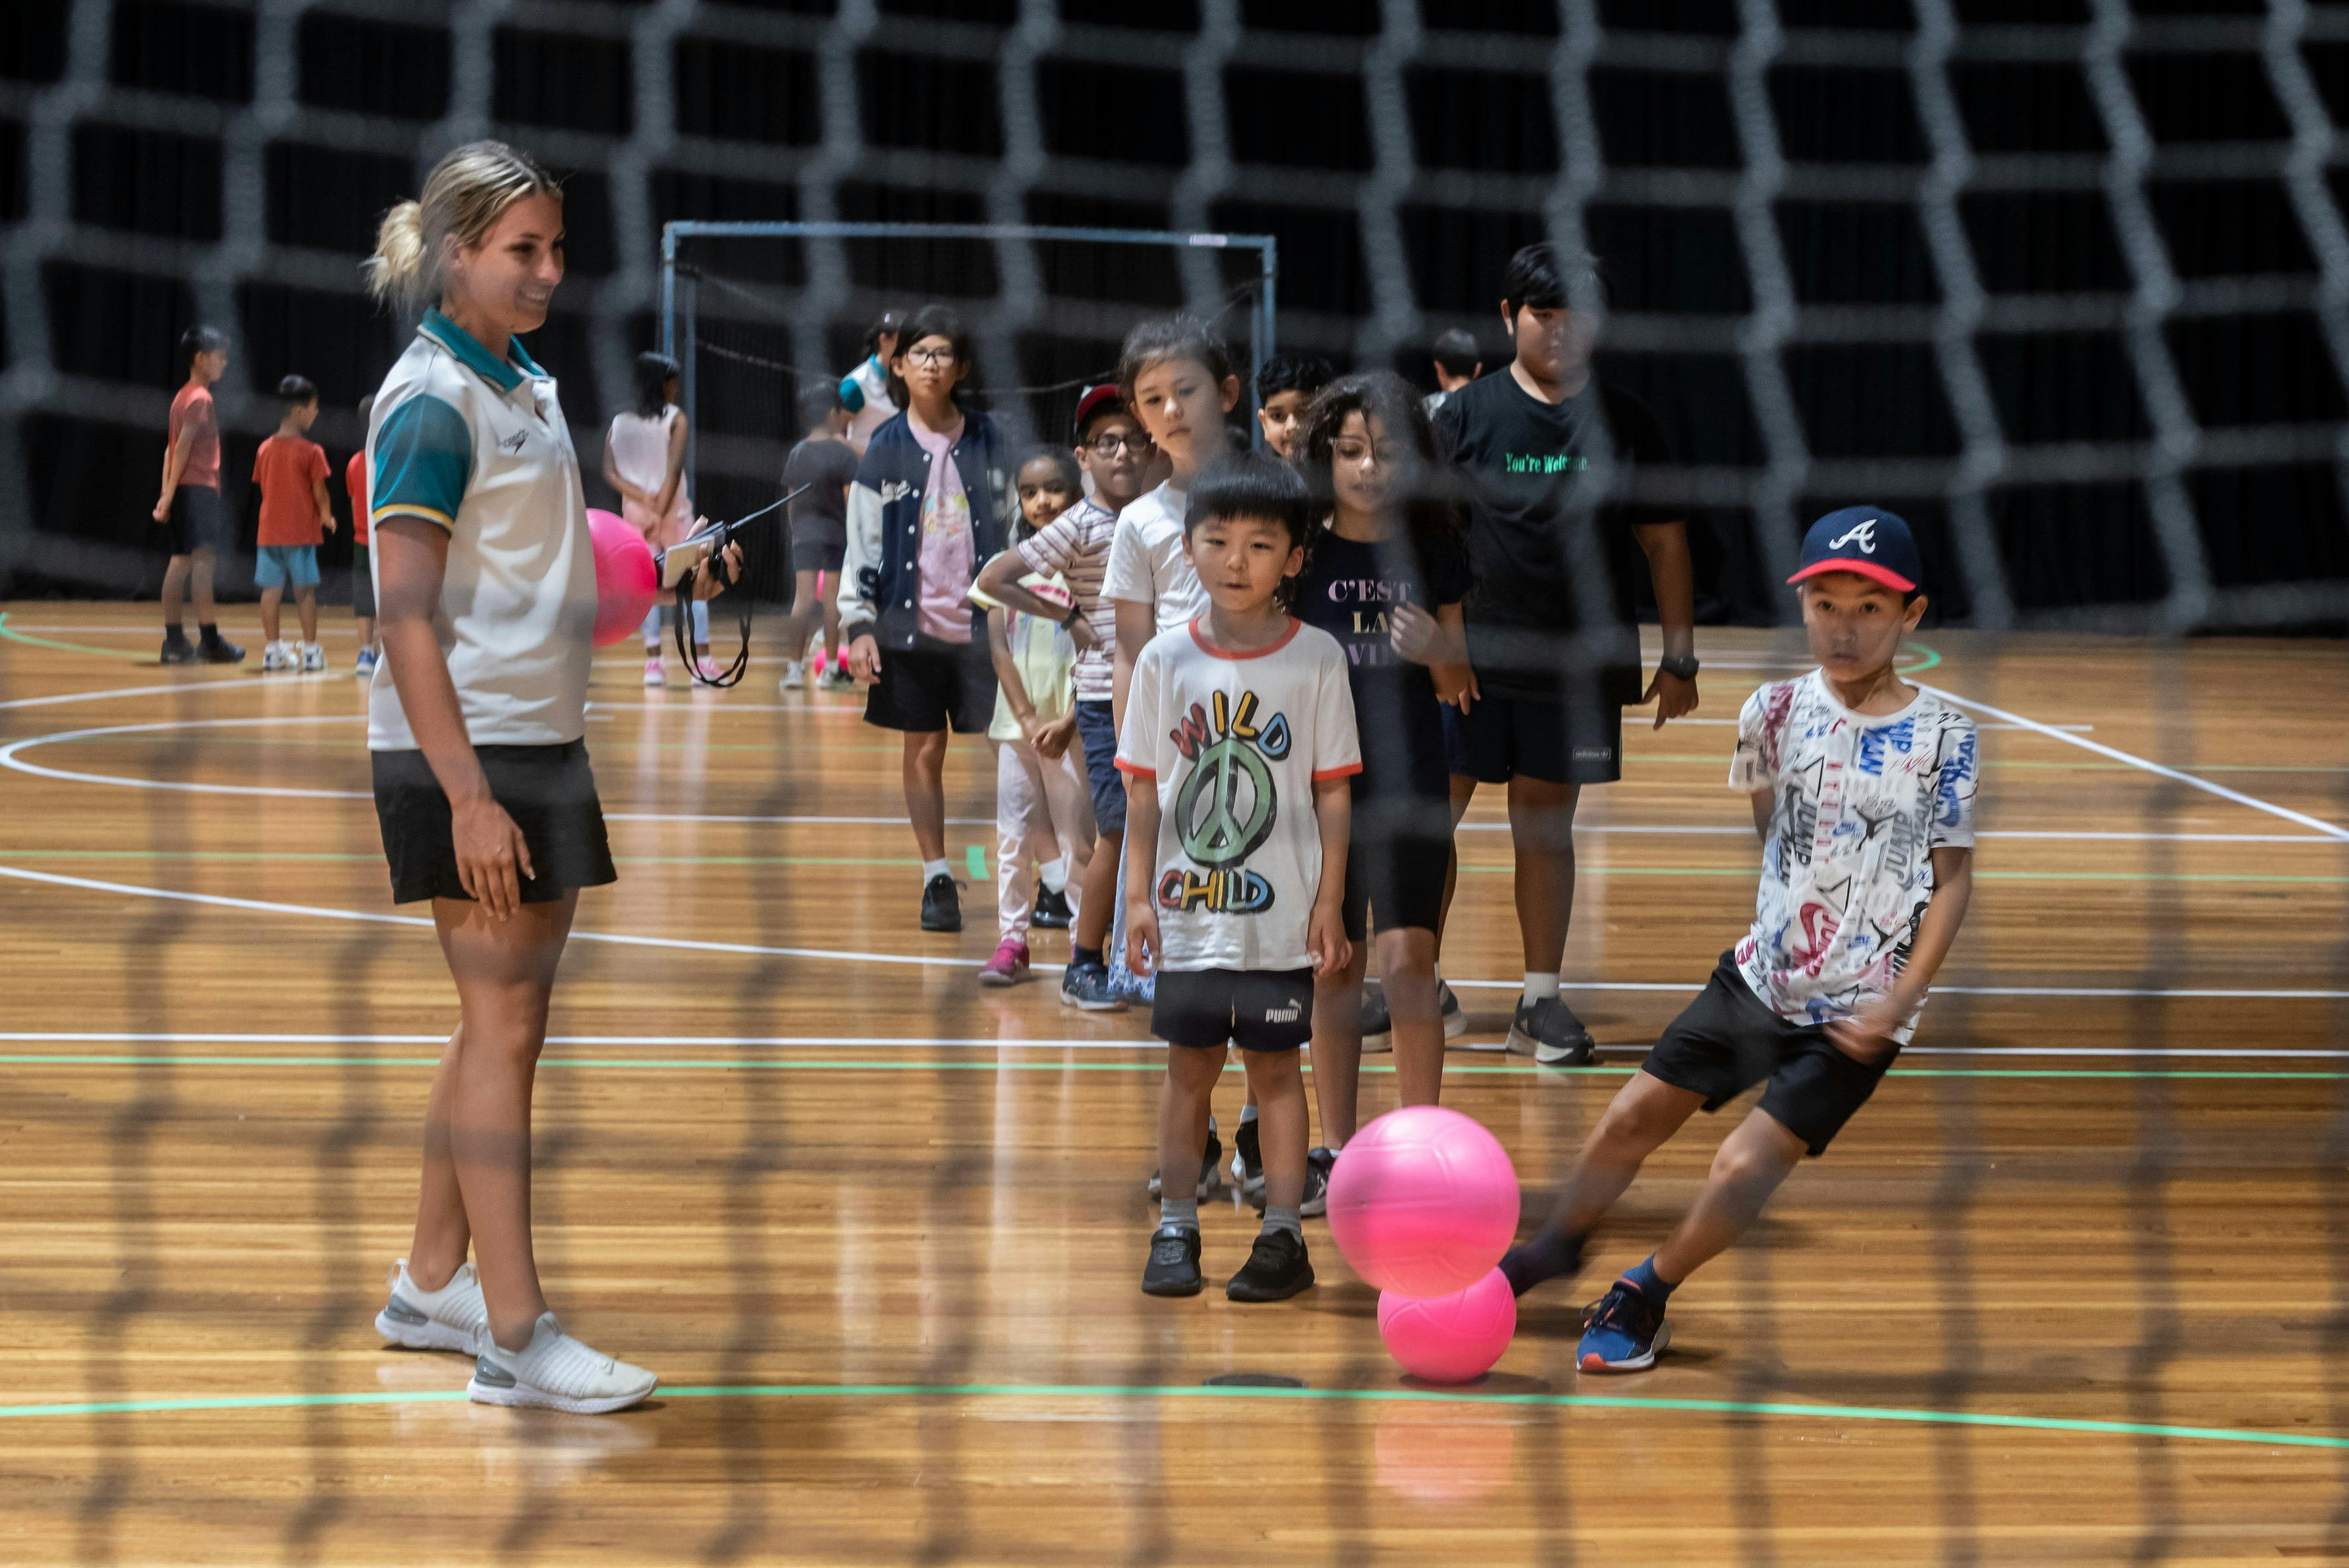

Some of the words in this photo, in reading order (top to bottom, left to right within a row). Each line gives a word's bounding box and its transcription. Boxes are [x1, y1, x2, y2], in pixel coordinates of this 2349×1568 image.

[1506, 452, 1541, 473] You're
[1829, 519, 1878, 554] A
[1328, 579, 1412, 603] C'EST
[1351, 611, 1392, 634] LA
[1170, 690, 1292, 761] WILD
[1158, 869, 1276, 914] CHILD
[1266, 1008, 1298, 1023] PUMA
